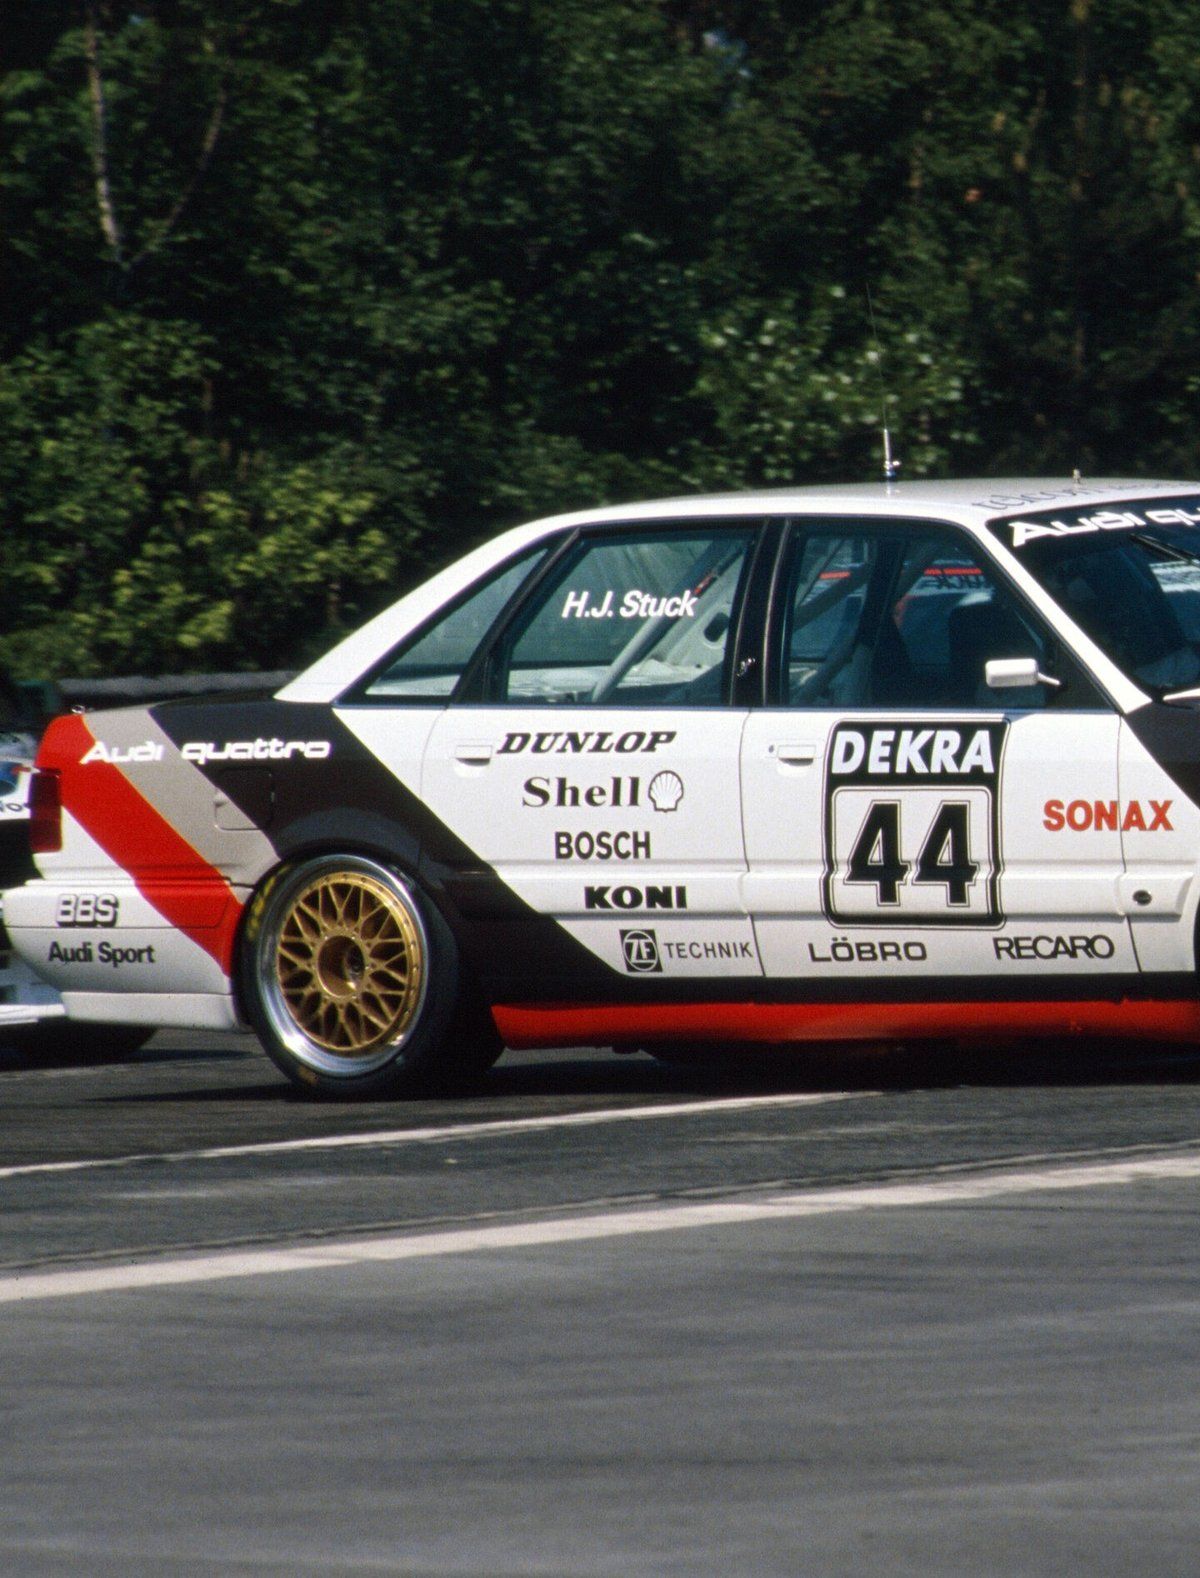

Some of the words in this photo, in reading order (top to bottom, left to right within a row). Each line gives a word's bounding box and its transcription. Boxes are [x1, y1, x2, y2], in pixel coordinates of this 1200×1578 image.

[1009, 511, 1146, 547] Audi
[562, 591, 613, 618] H.J.
[620, 589, 699, 618] Stuck
[80, 741, 164, 765] Audi
[181, 739, 331, 764] quattro
[497, 731, 677, 754] DUNLOP
[831, 730, 995, 775] DEKRA
[522, 776, 640, 807] Shell
[1043, 800, 1174, 832] SONAX
[555, 831, 651, 860] BOSCH
[843, 799, 981, 908] 44
[55, 894, 118, 928] BBS
[584, 886, 687, 910] KONI
[48, 941, 94, 964] Audi
[97, 941, 155, 965] Sport
[663, 941, 754, 960] TECHNIK
[808, 937, 928, 963] LÖBRO
[993, 935, 1115, 960] RECARO
